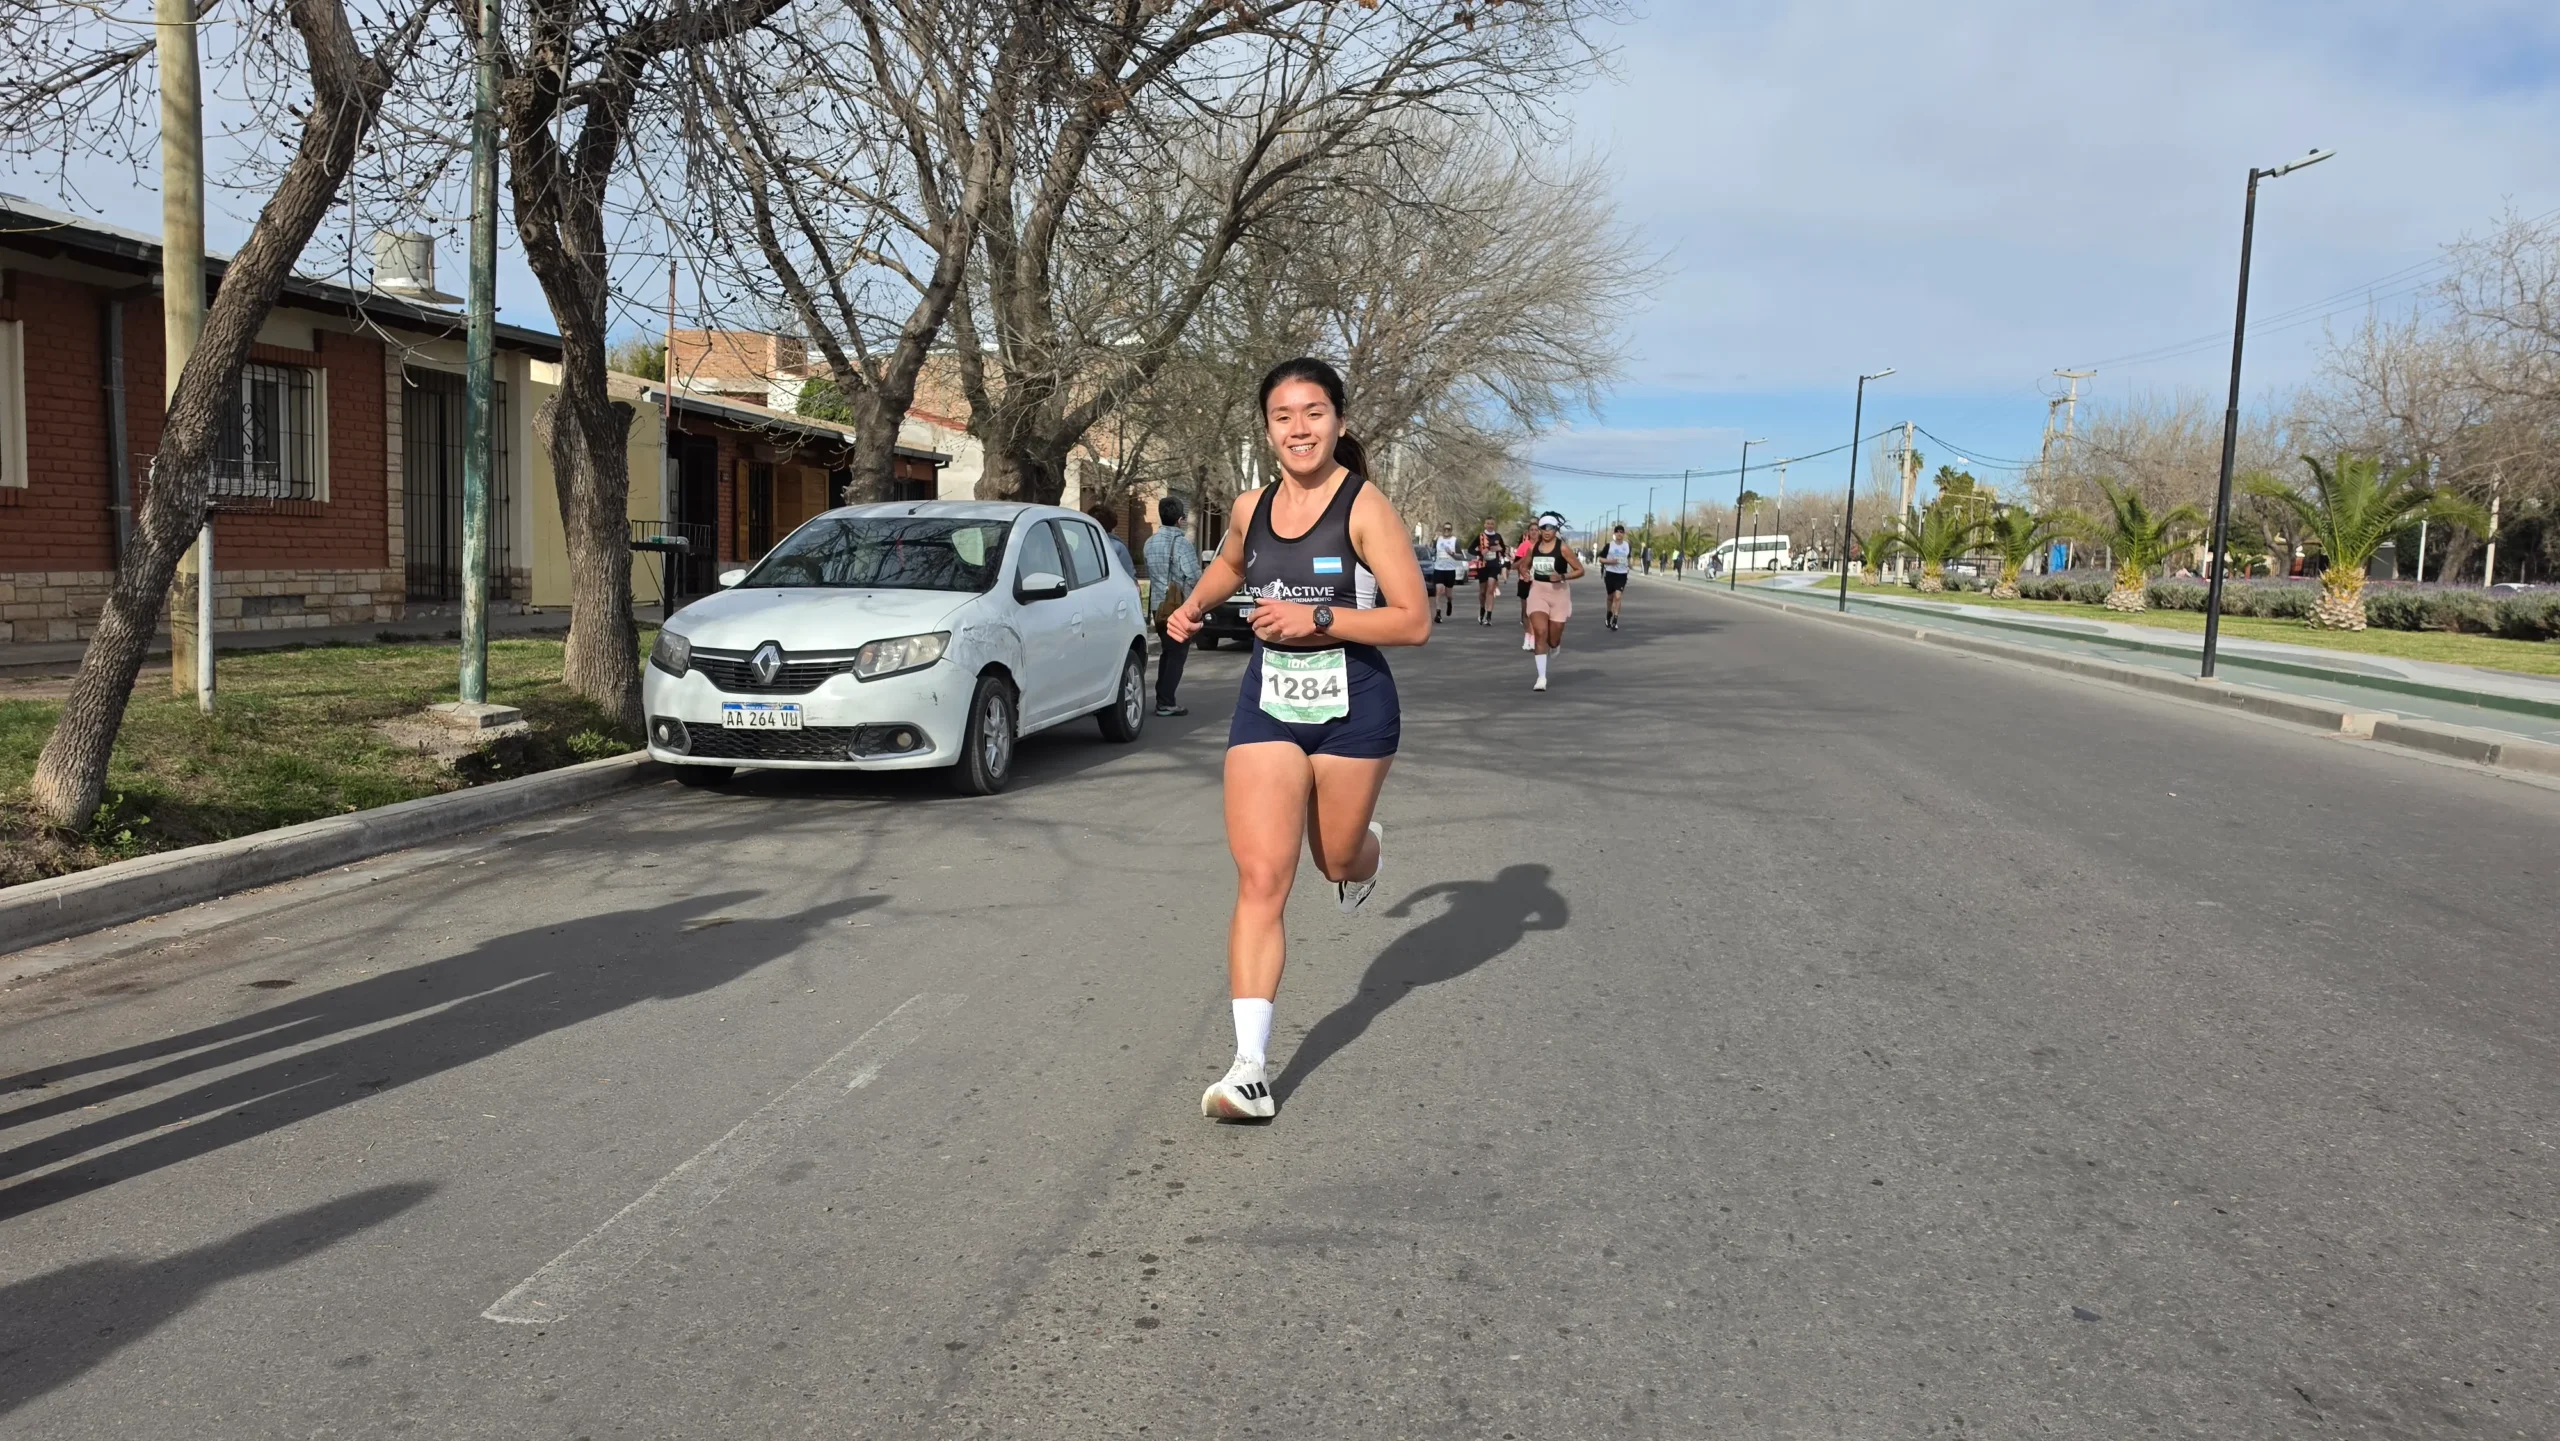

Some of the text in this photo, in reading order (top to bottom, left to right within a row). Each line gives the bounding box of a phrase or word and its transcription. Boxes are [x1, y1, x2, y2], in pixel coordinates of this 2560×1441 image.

[1268, 674, 1341, 700] 1284
[726, 711, 744, 726] AA
[749, 712, 776, 727] 264
